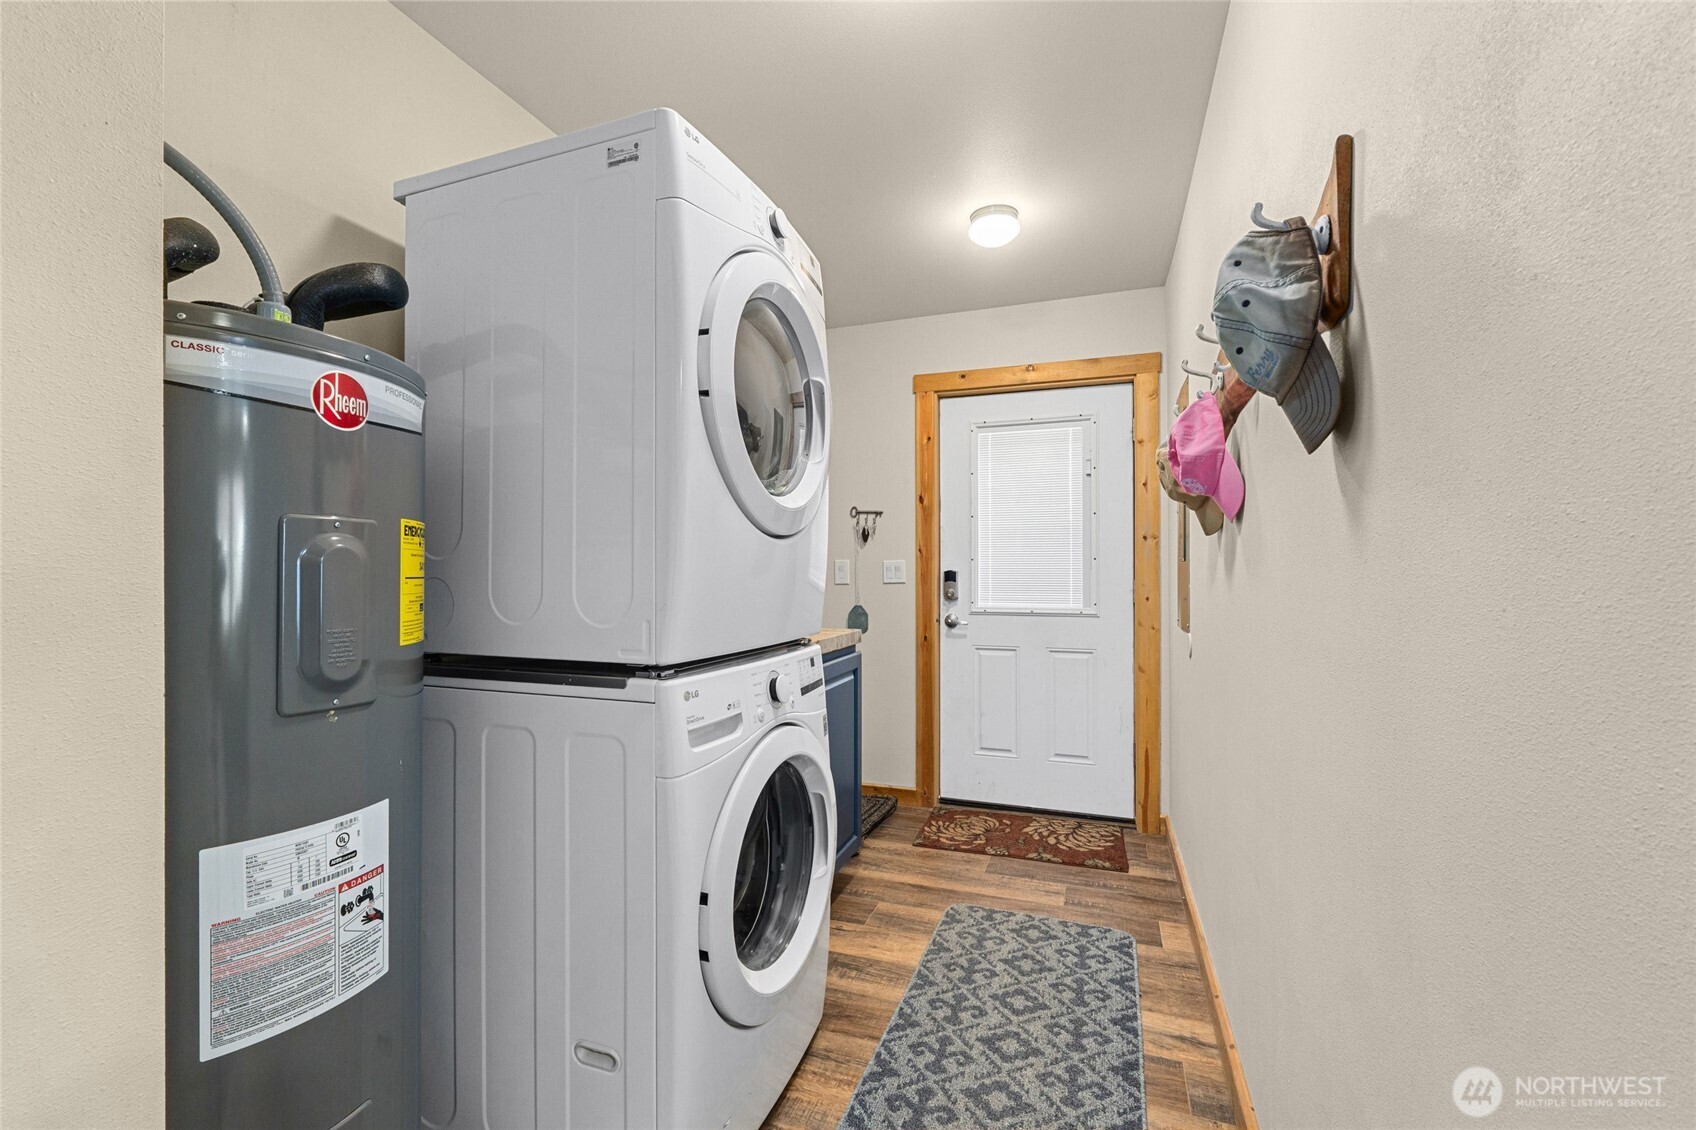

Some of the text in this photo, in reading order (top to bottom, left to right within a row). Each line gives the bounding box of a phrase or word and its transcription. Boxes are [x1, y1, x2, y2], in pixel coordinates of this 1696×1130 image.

[691, 133, 700, 144] LG
[170, 340, 225, 355] CLASSIC
[320, 372, 367, 420] Rheem
[384, 385, 423, 410] PROFESSIONAL
[691, 690, 699, 699] LG
[350, 867, 383, 887] DANGER
[313, 887, 336, 898] CAUTION
[211, 917, 241, 928] WARNING
